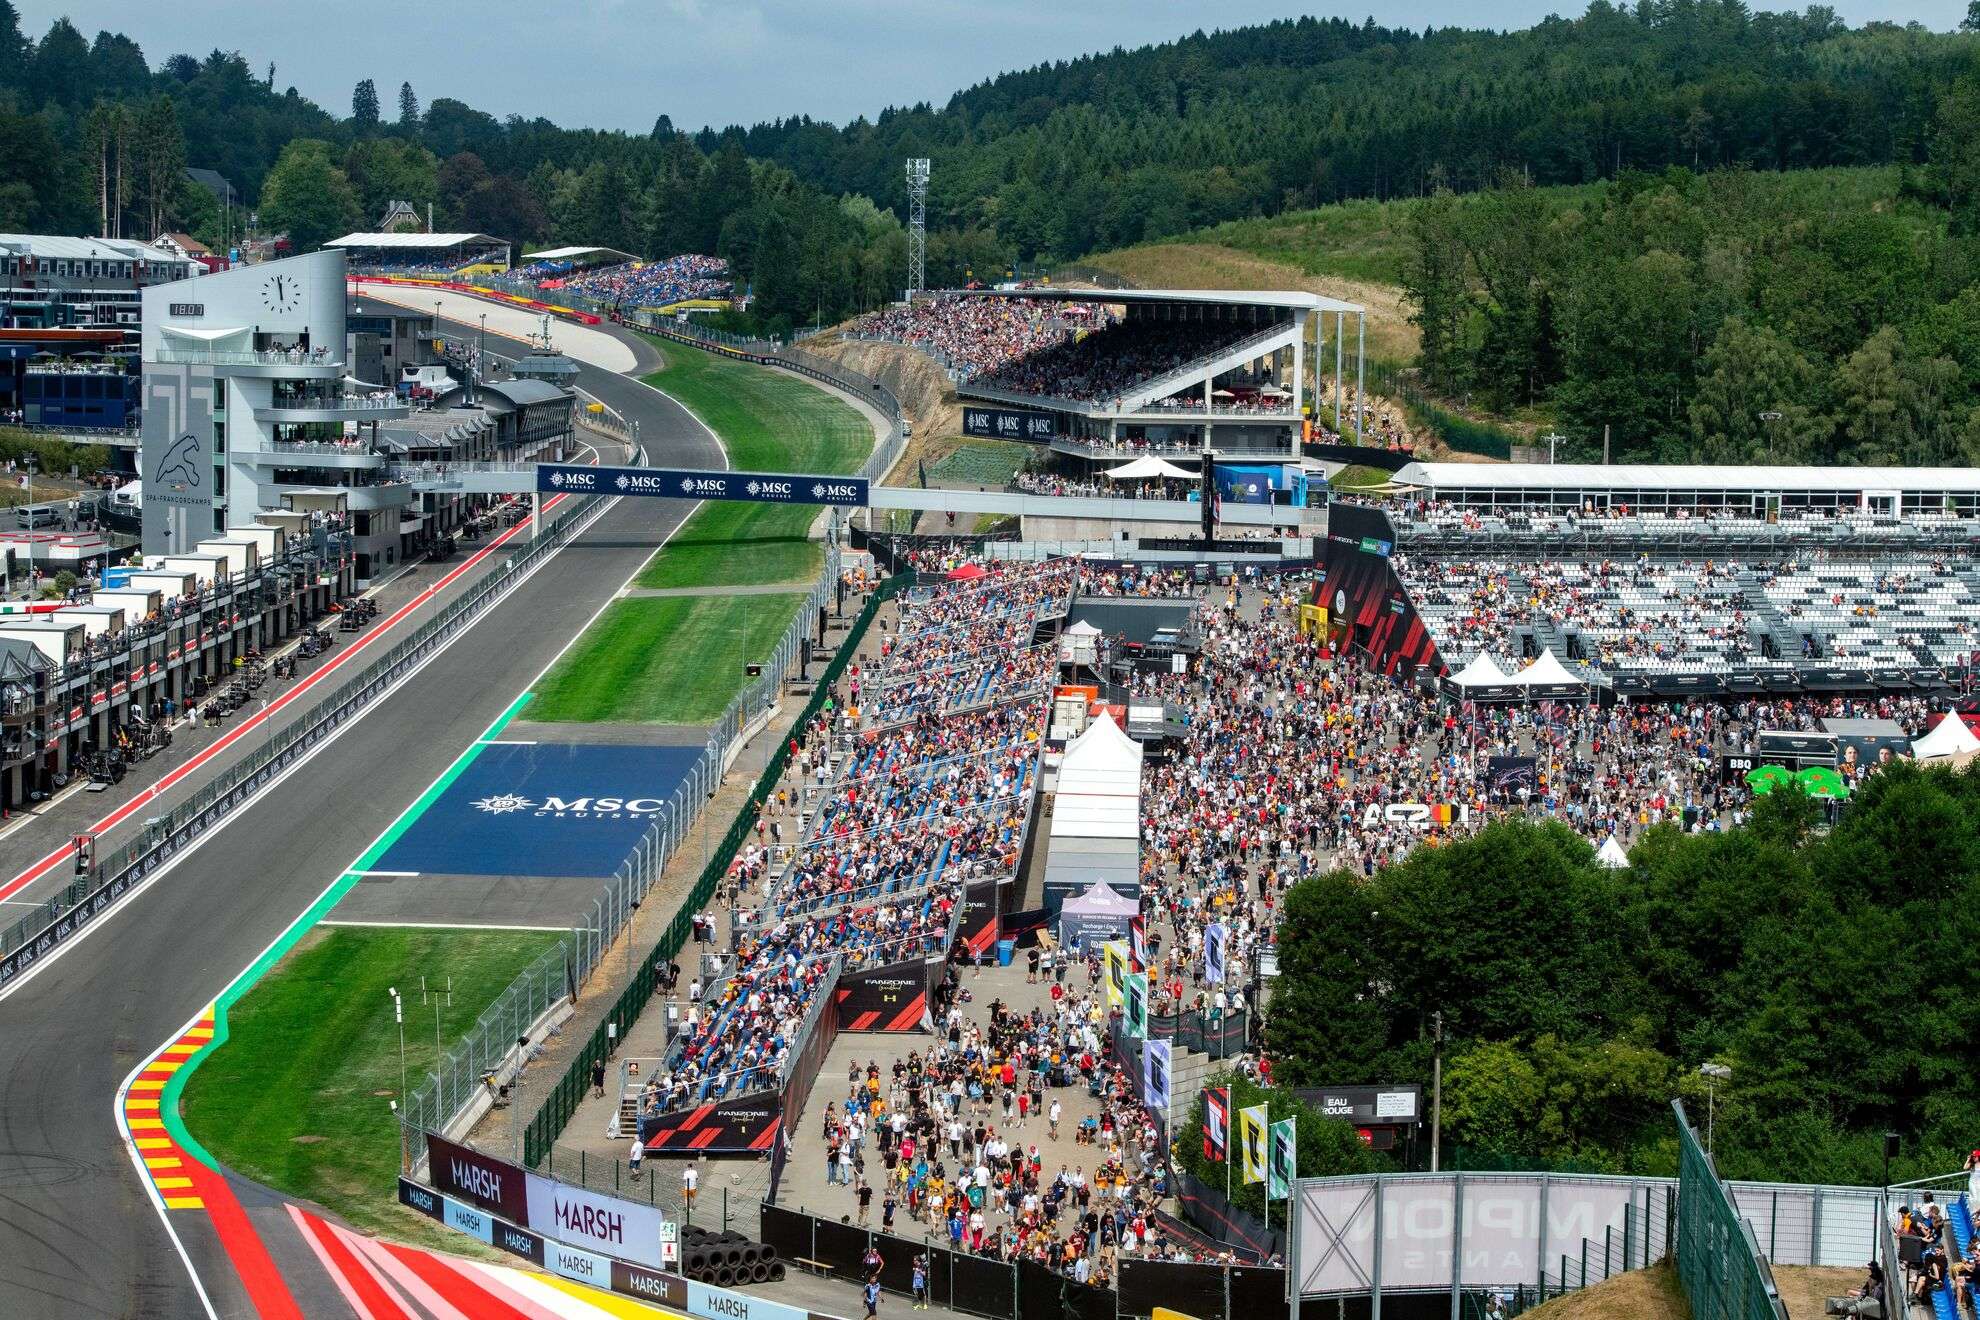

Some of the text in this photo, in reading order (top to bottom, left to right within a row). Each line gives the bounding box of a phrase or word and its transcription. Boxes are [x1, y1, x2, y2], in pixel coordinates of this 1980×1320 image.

[974, 414, 990, 427] MSC
[1004, 416, 1020, 430] MSC
[1034, 419, 1050, 432] MSC
[566, 474, 595, 484] MSC
[631, 476, 660, 488] MSC
[696, 480, 726, 490] MSC
[762, 482, 792, 494] MSC
[827, 486, 857, 496] MSC
[1730, 759, 1752, 769] BBQ
[538, 796, 664, 812] MSC
[1328, 1098, 1348, 1106] EAU
[451, 1156, 501, 1203] MARSH
[410, 1188, 432, 1211] MARSH
[456, 1210, 480, 1232] MARSH
[555, 1197, 624, 1244] MARSH
[505, 1231, 532, 1255] MARSH
[558, 1252, 593, 1276] MARSH
[630, 1272, 669, 1298] MARSH
[708, 1294, 748, 1320] MARSH
